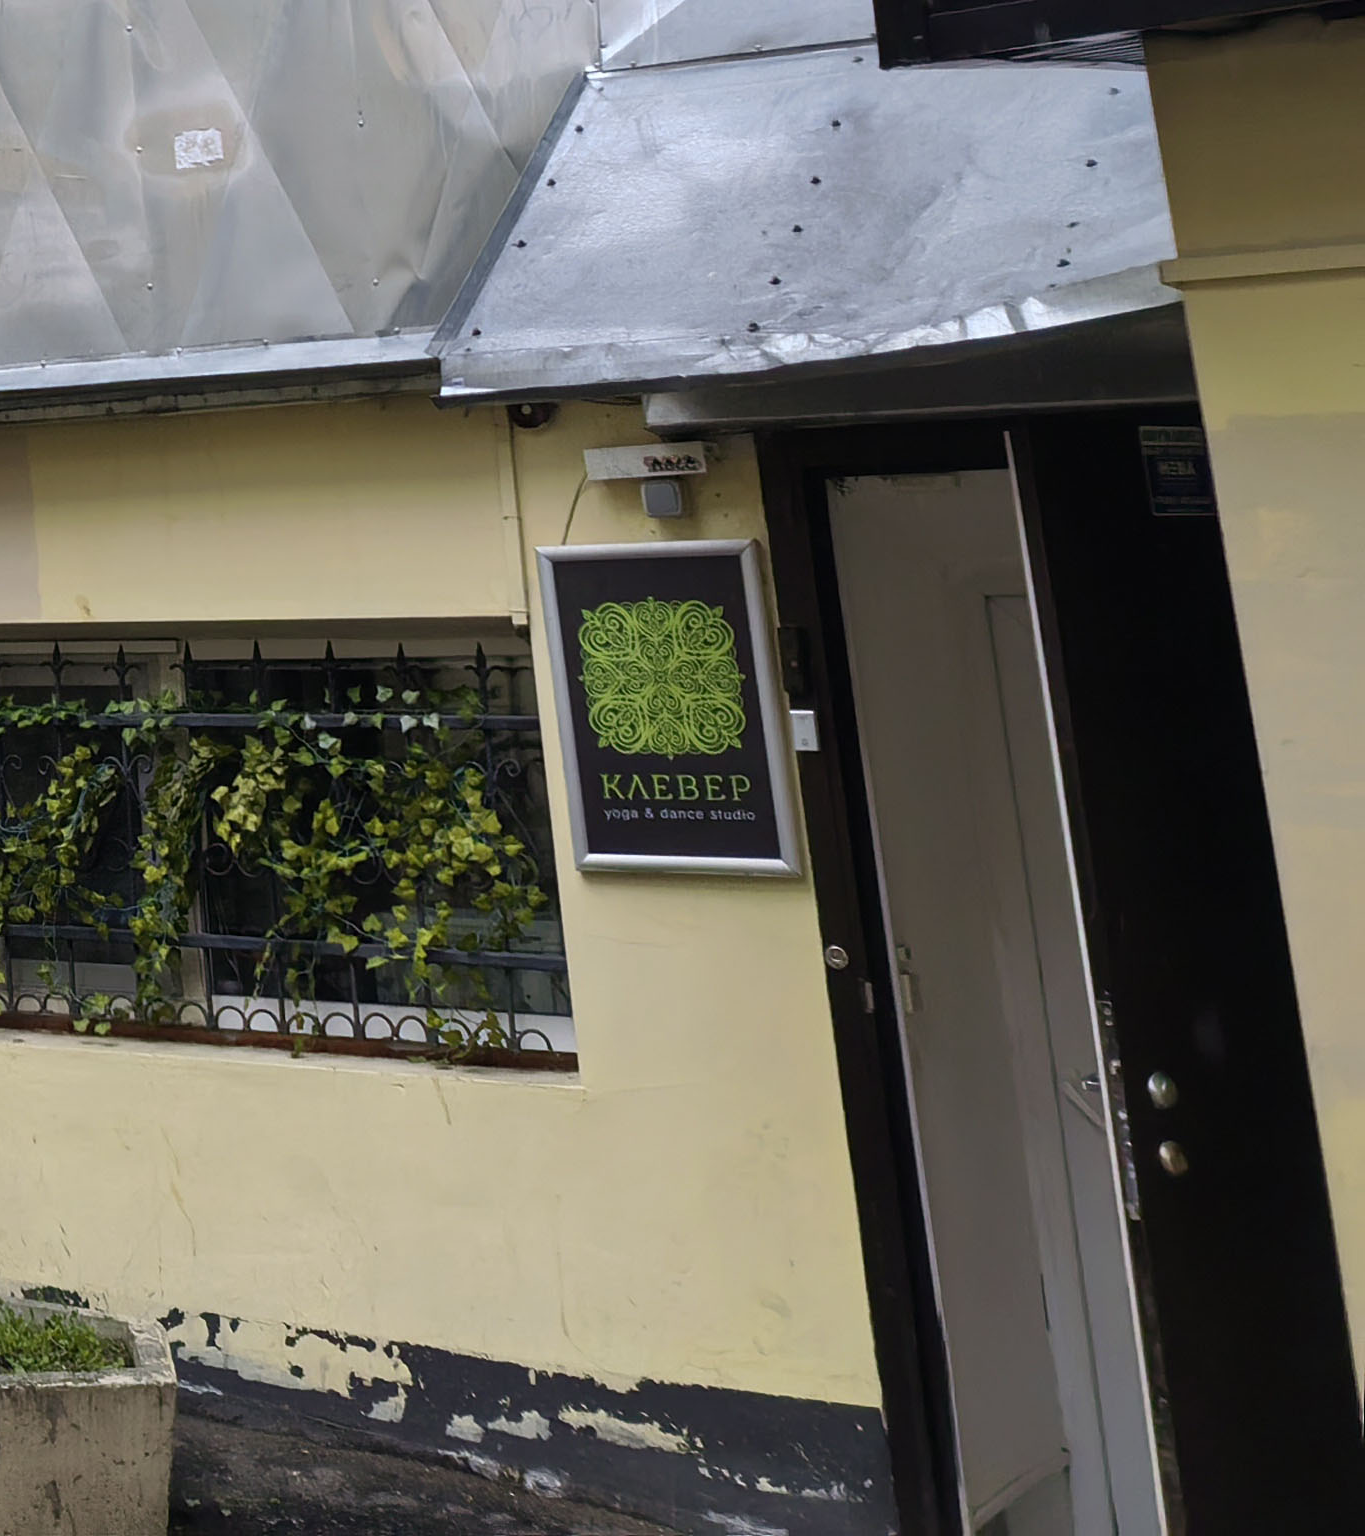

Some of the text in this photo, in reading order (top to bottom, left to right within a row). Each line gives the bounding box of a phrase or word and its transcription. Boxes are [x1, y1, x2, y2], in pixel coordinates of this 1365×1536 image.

[599, 773, 751, 801] КЛЕВЕР
[603, 807, 756, 821] yoga & dance studio
